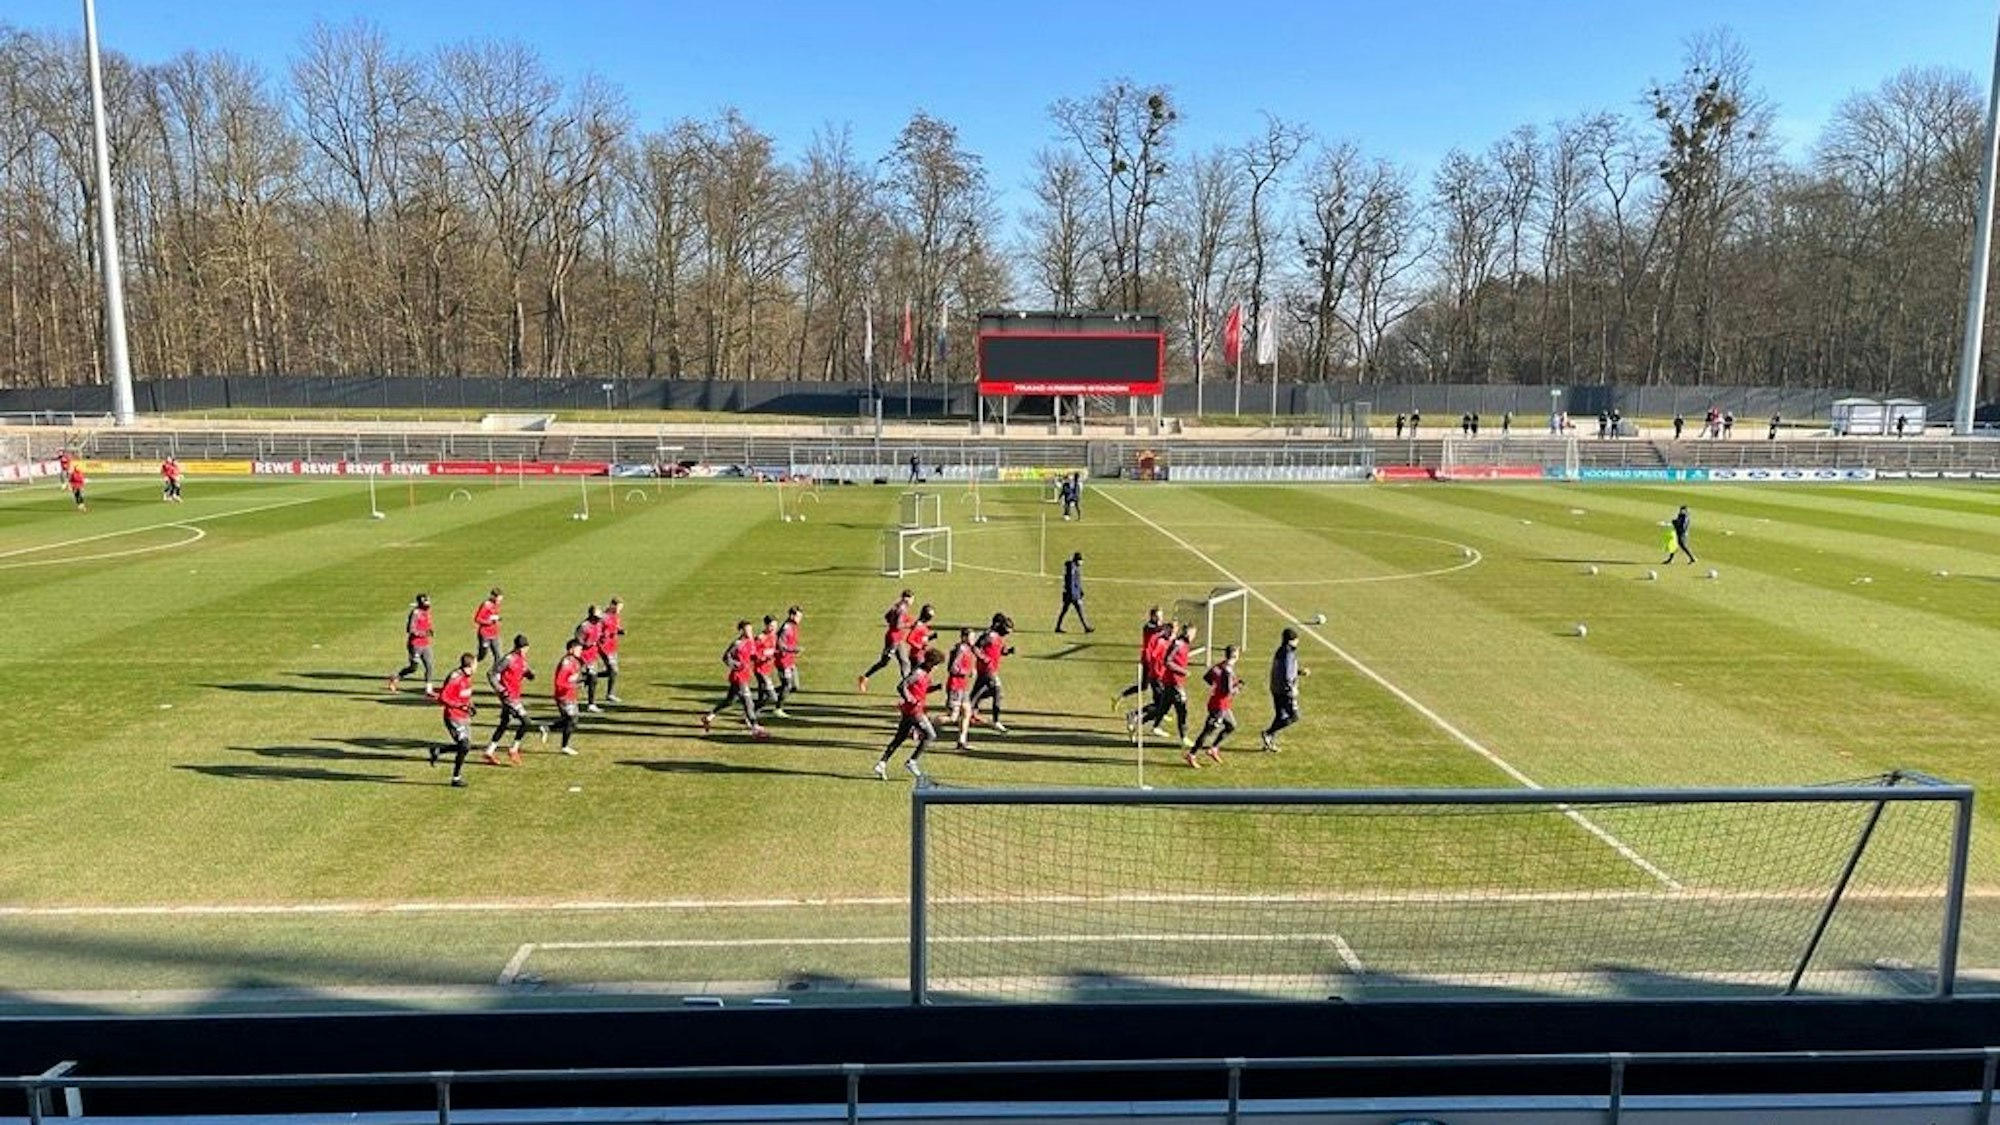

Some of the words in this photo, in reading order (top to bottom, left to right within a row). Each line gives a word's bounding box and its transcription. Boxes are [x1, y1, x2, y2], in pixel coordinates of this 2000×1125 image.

[255, 462, 294, 474] REWE
[301, 462, 340, 474] REWE
[346, 462, 385, 475] REWE
[392, 462, 431, 475] REWE
